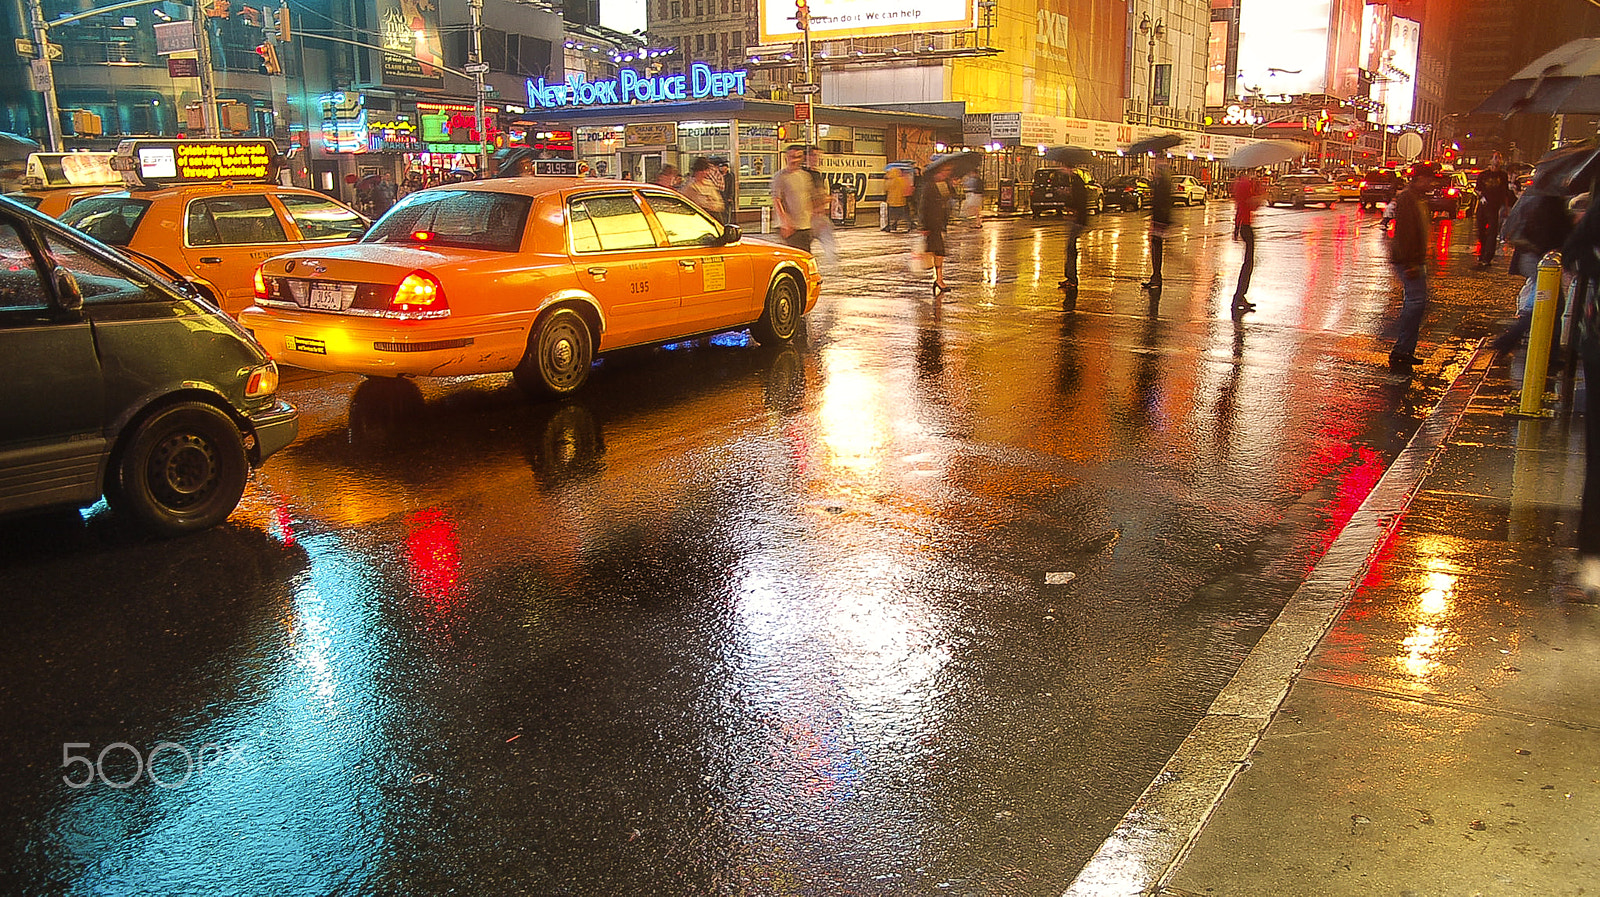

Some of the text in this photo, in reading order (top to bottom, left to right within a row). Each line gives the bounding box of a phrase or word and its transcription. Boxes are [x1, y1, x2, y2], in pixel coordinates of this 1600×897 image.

[865, 12, 880, 20] We
[900, 9, 922, 19] help
[527, 62, 747, 108] NEW YORK POLICE DEPT
[586, 130, 616, 142] POLICE
[686, 126, 722, 138] POLICE
[178, 144, 266, 156] Celebrating a decade
[178, 155, 269, 167] of serving sports fans
[182, 166, 219, 178] through
[546, 163, 567, 174] 3L95
[630, 281, 650, 294] 3L95
